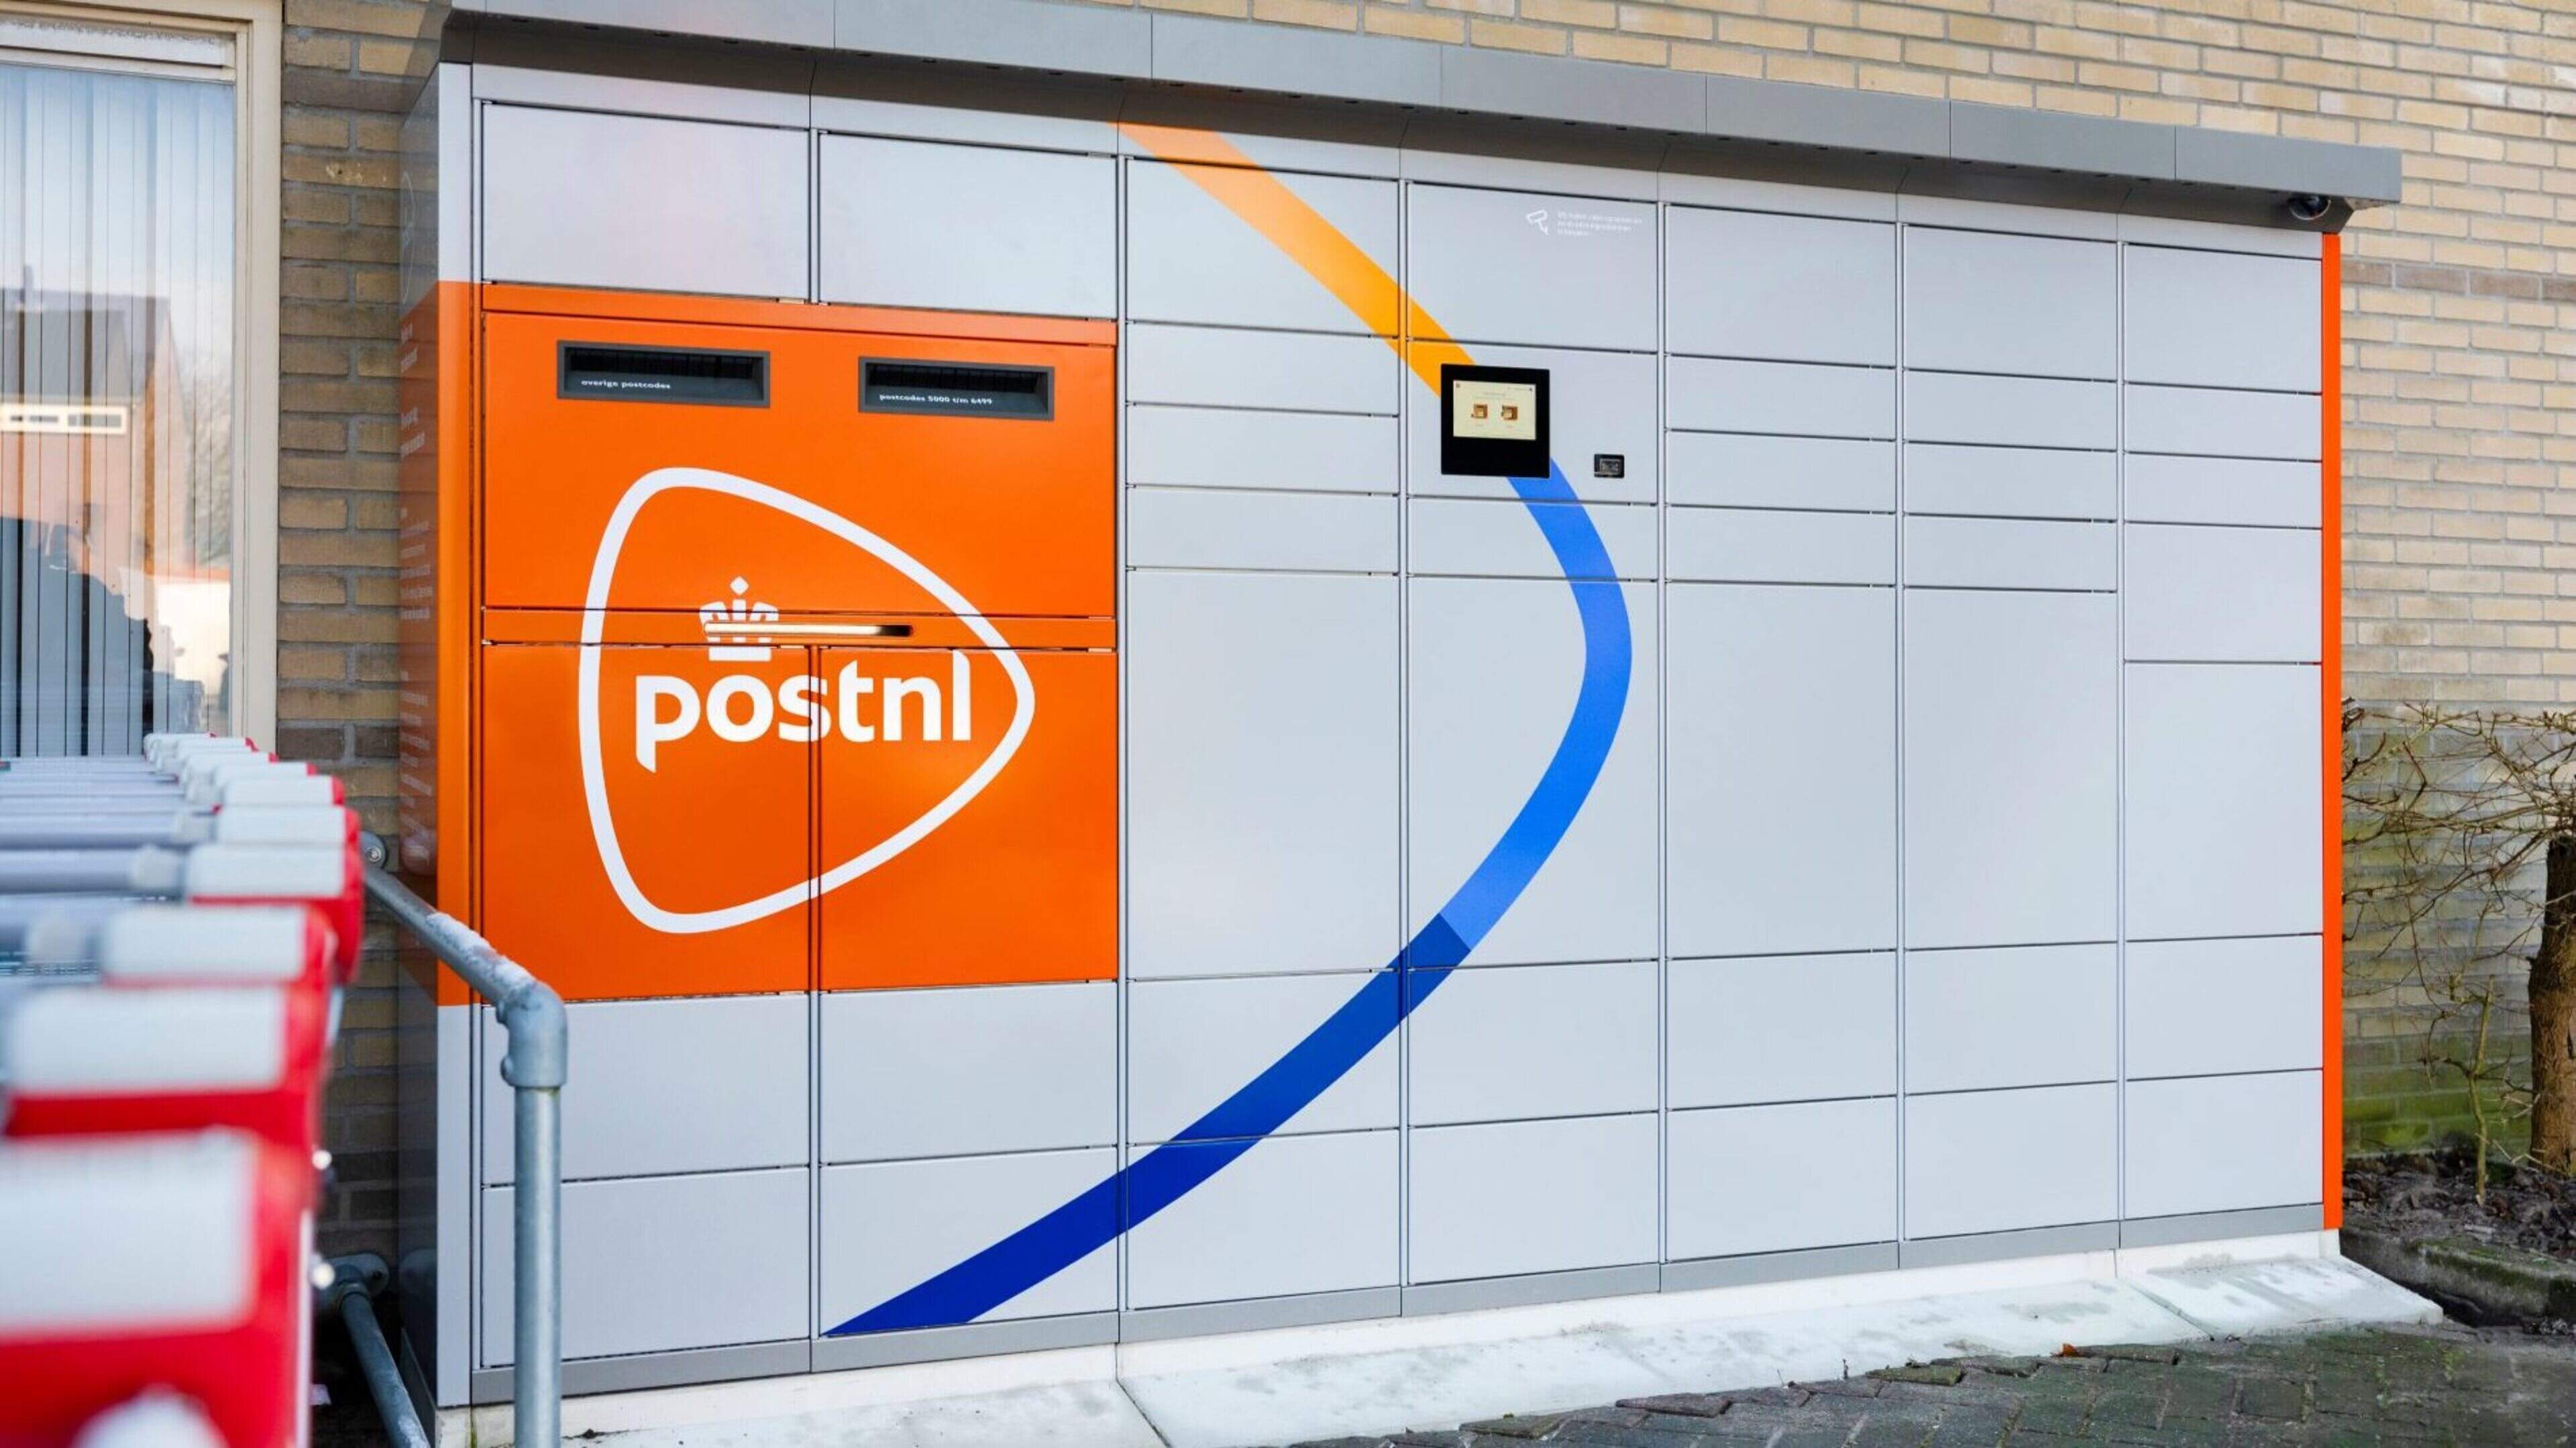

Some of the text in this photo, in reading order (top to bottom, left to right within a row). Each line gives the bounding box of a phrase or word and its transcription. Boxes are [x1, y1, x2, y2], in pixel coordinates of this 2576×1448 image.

[581, 380, 671, 389] overige postcodes
[879, 393, 925, 402] postcodes
[635, 650, 971, 773] postnl
